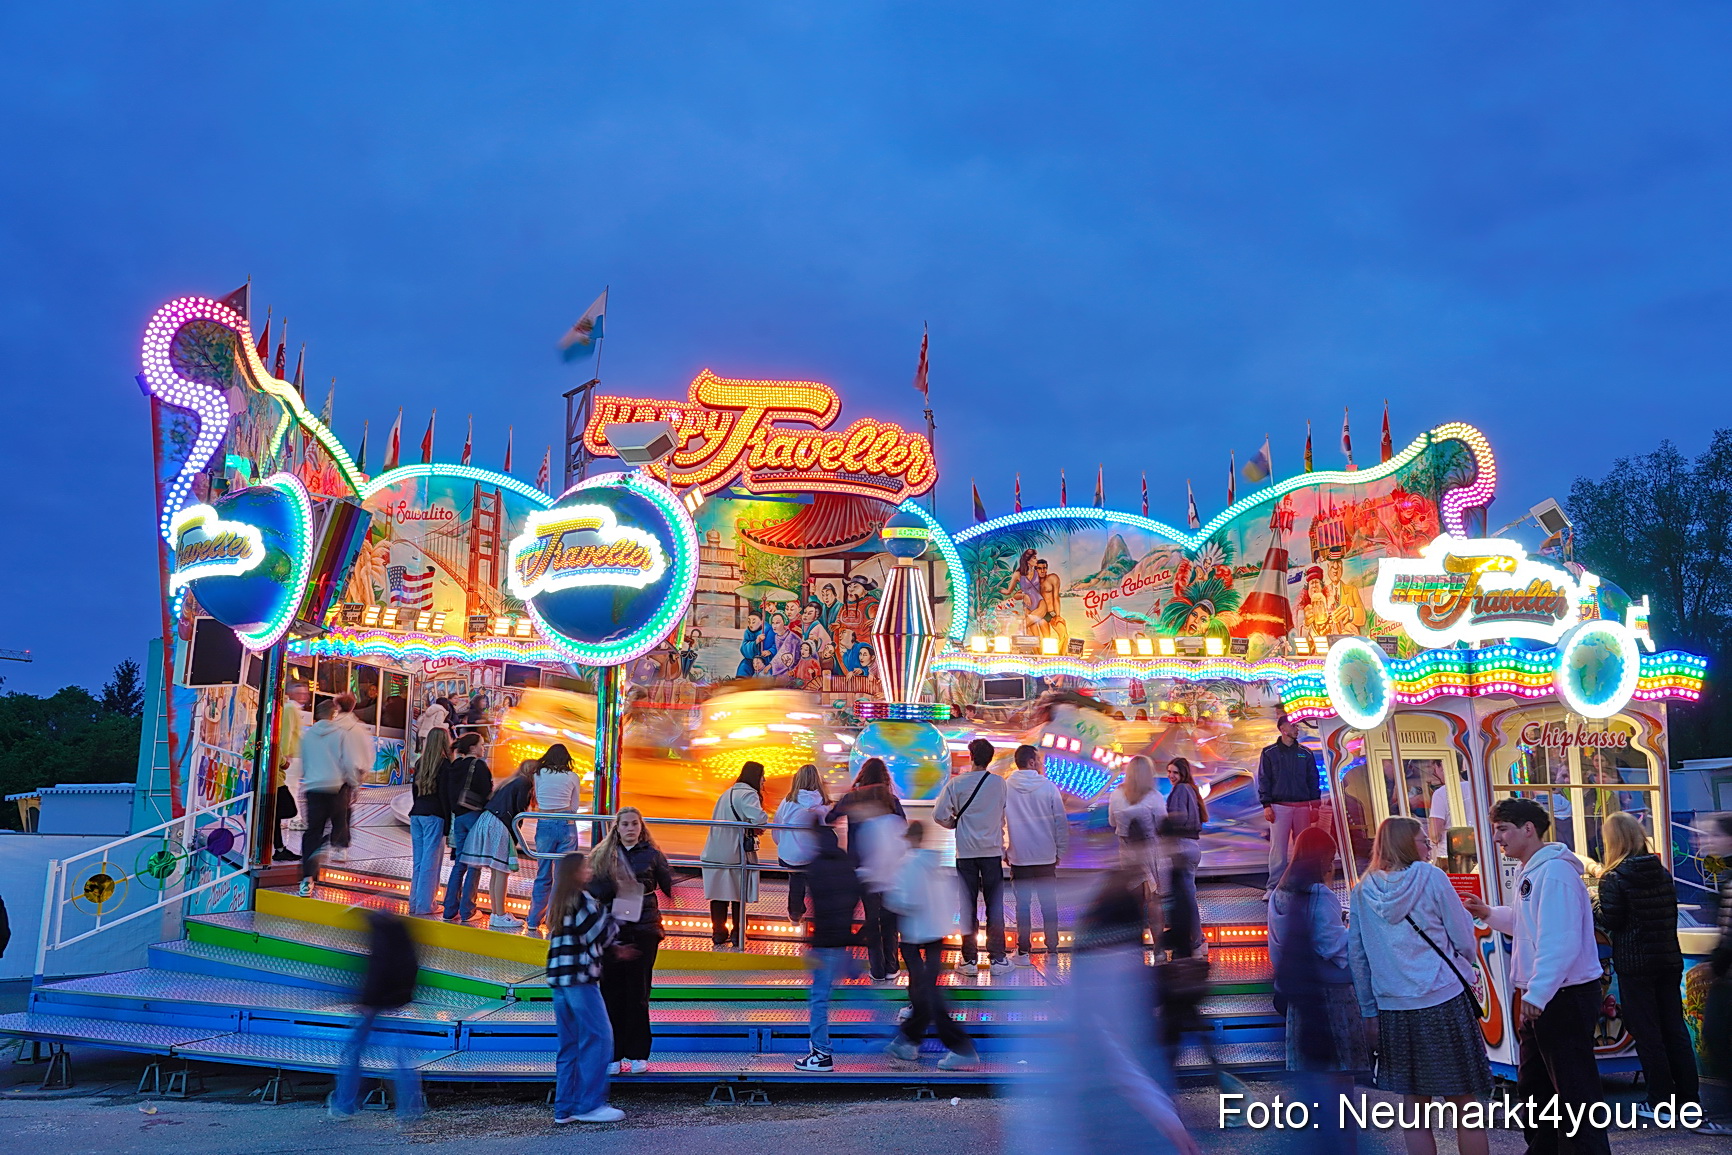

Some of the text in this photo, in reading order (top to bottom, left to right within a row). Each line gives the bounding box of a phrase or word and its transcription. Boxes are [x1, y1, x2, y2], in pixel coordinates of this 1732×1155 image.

[651, 377, 930, 486] Traveller
[516, 517, 656, 587] Traveller
[1083, 569, 1171, 611] Copa Cabana
[1417, 552, 1570, 631] Traveller
[1520, 720, 1628, 757] Chipkasse
